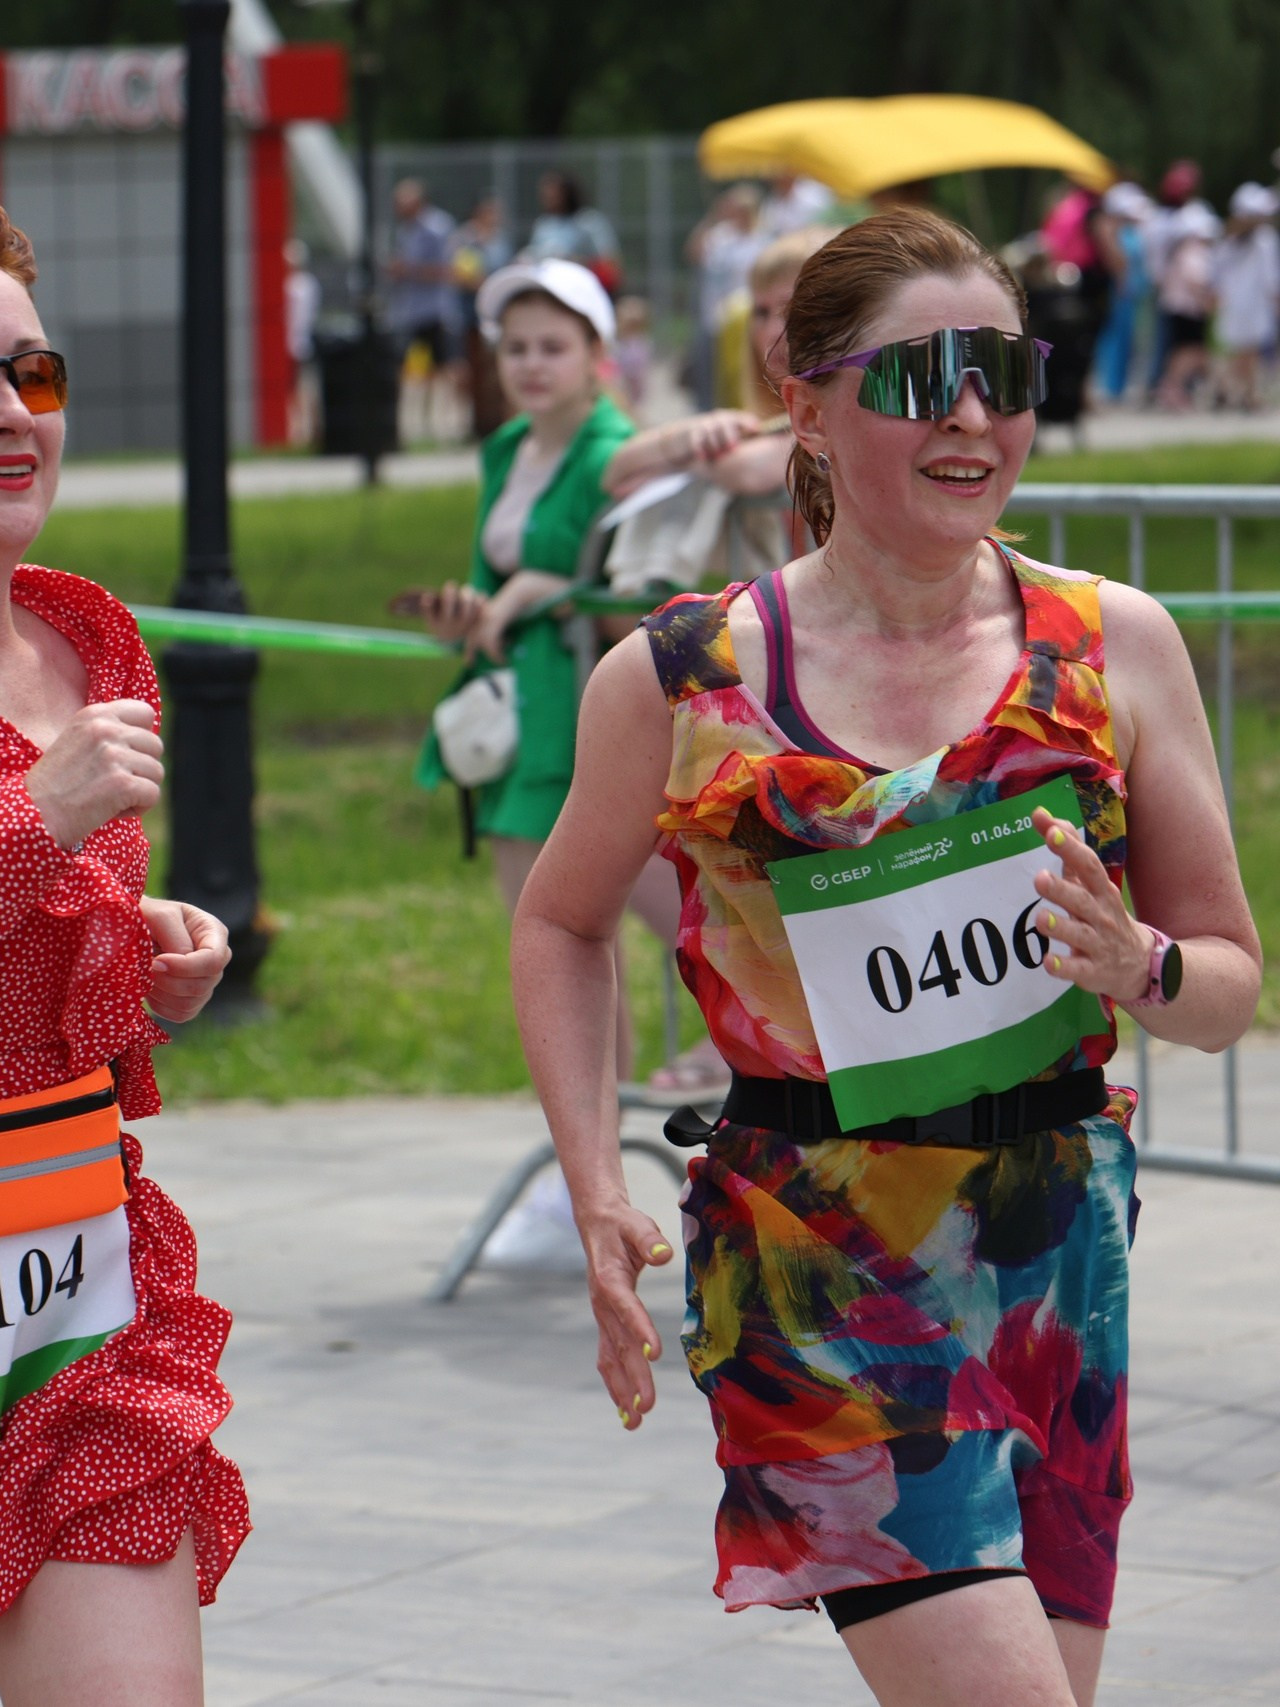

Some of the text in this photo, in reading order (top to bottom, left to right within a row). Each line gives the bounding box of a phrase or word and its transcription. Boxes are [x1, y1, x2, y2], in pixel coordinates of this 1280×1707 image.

[971, 816, 1032, 845] 01.06.20
[891, 854, 932, 871] марафон
[831, 865, 871, 885] СБЕР
[867, 897, 1050, 1013] 0406
